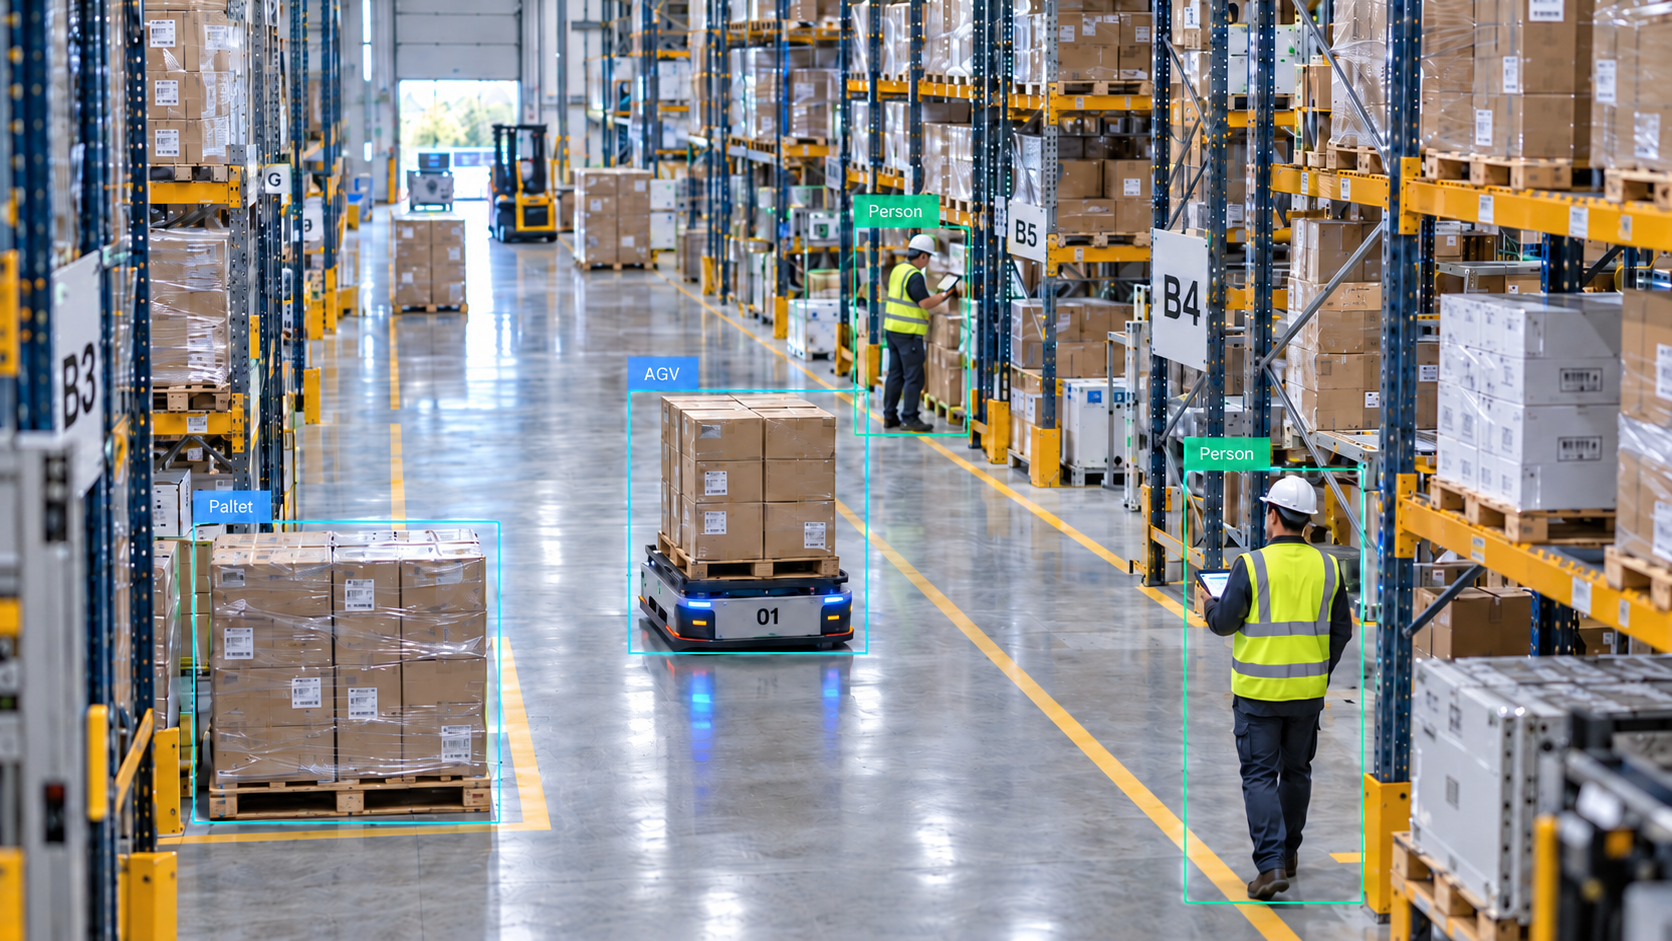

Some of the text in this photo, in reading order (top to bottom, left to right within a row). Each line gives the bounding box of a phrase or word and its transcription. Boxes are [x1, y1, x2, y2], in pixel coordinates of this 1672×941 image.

[267, 172, 281, 187] G
[1015, 218, 1037, 248] B5
[1164, 273, 1201, 326] B4
[63, 341, 96, 431] B3
[756, 607, 779, 626] 01
